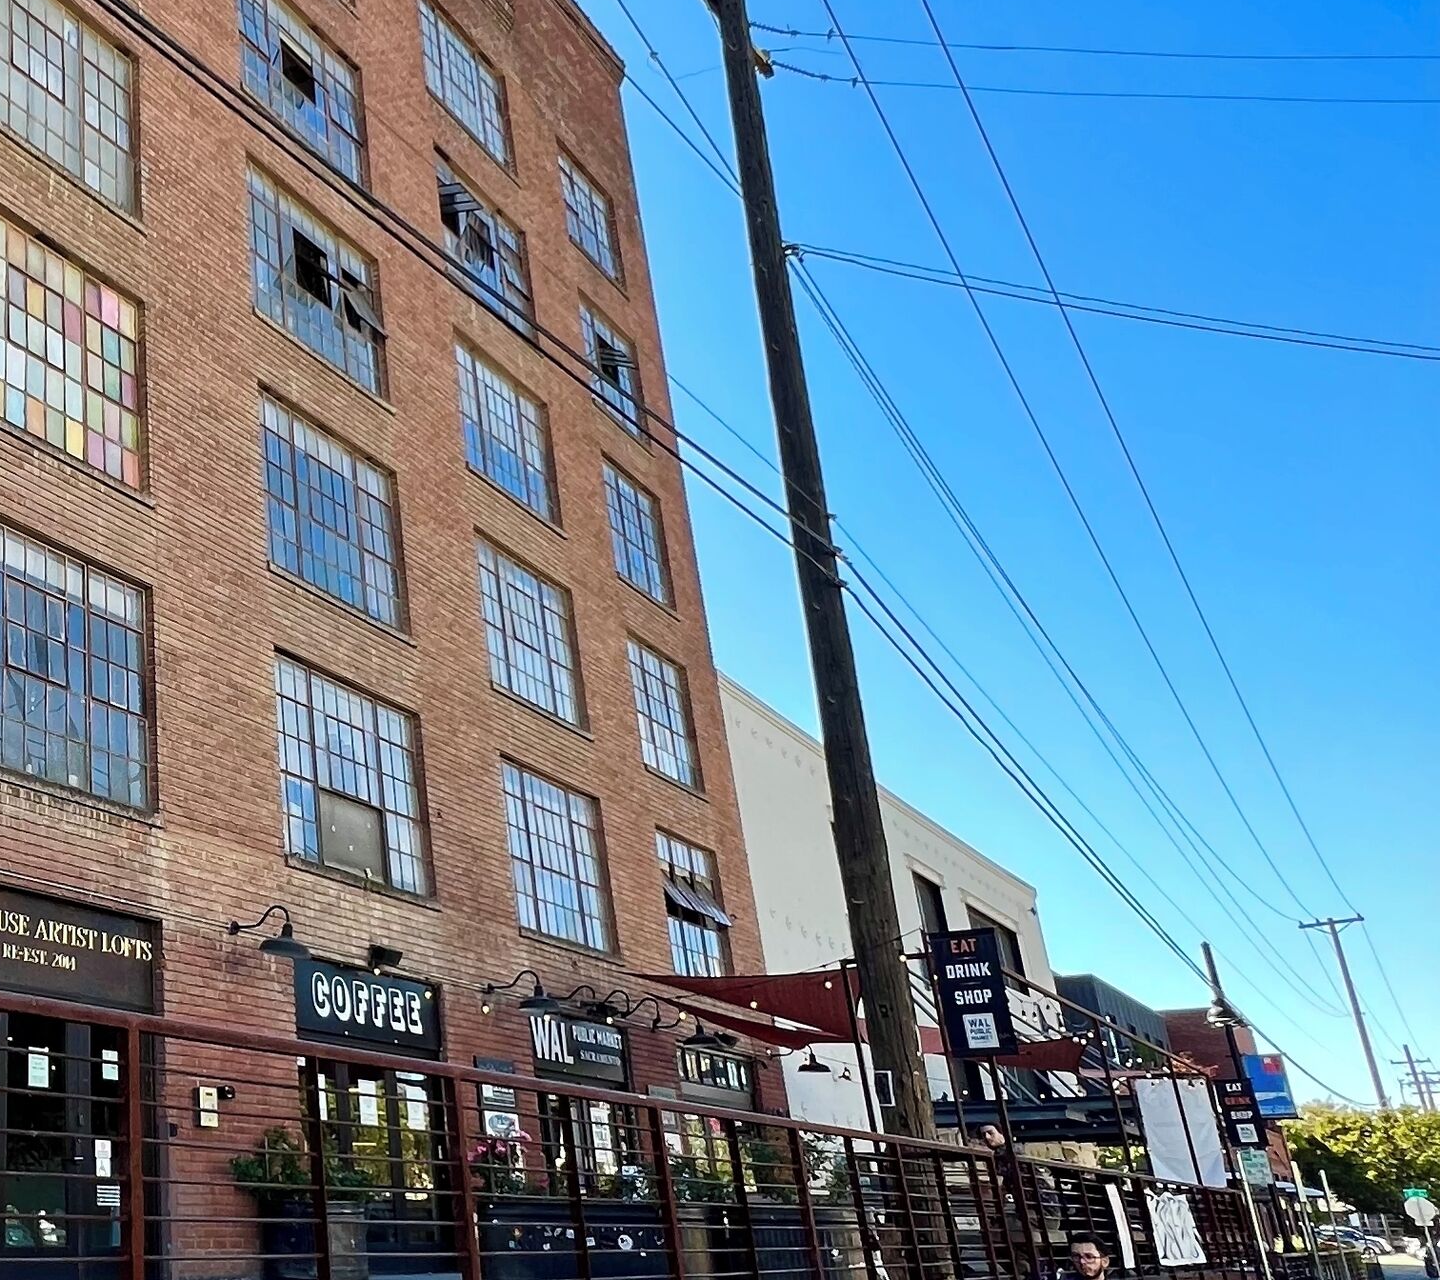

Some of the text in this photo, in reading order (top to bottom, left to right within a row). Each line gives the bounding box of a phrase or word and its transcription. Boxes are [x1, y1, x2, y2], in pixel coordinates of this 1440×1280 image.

[35, 918, 98, 950] ARTIST
[101, 931, 153, 961] LOFTS
[950, 938, 976, 953] EAT
[945, 962, 991, 979] DRINK
[311, 971, 423, 1035] COFFEE
[954, 989, 992, 1005] SHOP
[968, 1018, 991, 1028] WAL
[530, 1015, 574, 1064] WAL
